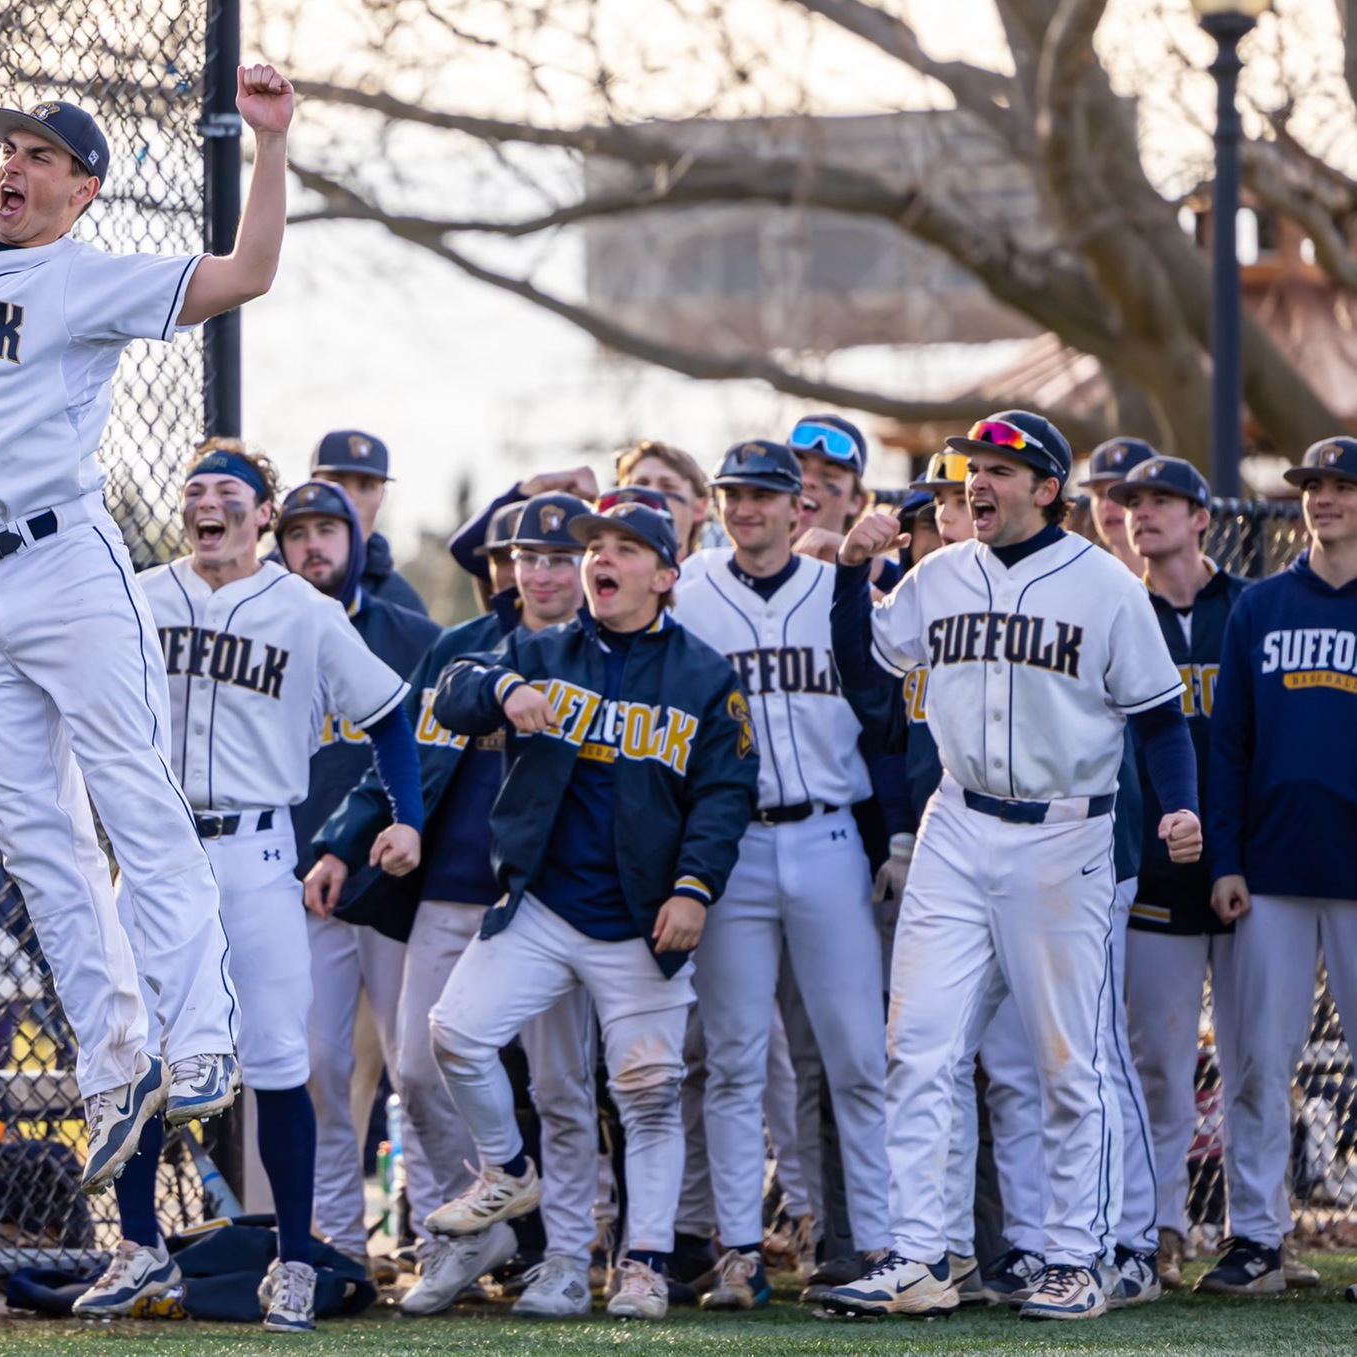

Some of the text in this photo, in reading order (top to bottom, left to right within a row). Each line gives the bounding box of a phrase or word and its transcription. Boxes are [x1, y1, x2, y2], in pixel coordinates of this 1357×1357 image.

[158, 626, 289, 700] FFOLK
[928, 611, 1084, 680] SUFFOLK
[1261, 628, 1357, 674] SUFFO
